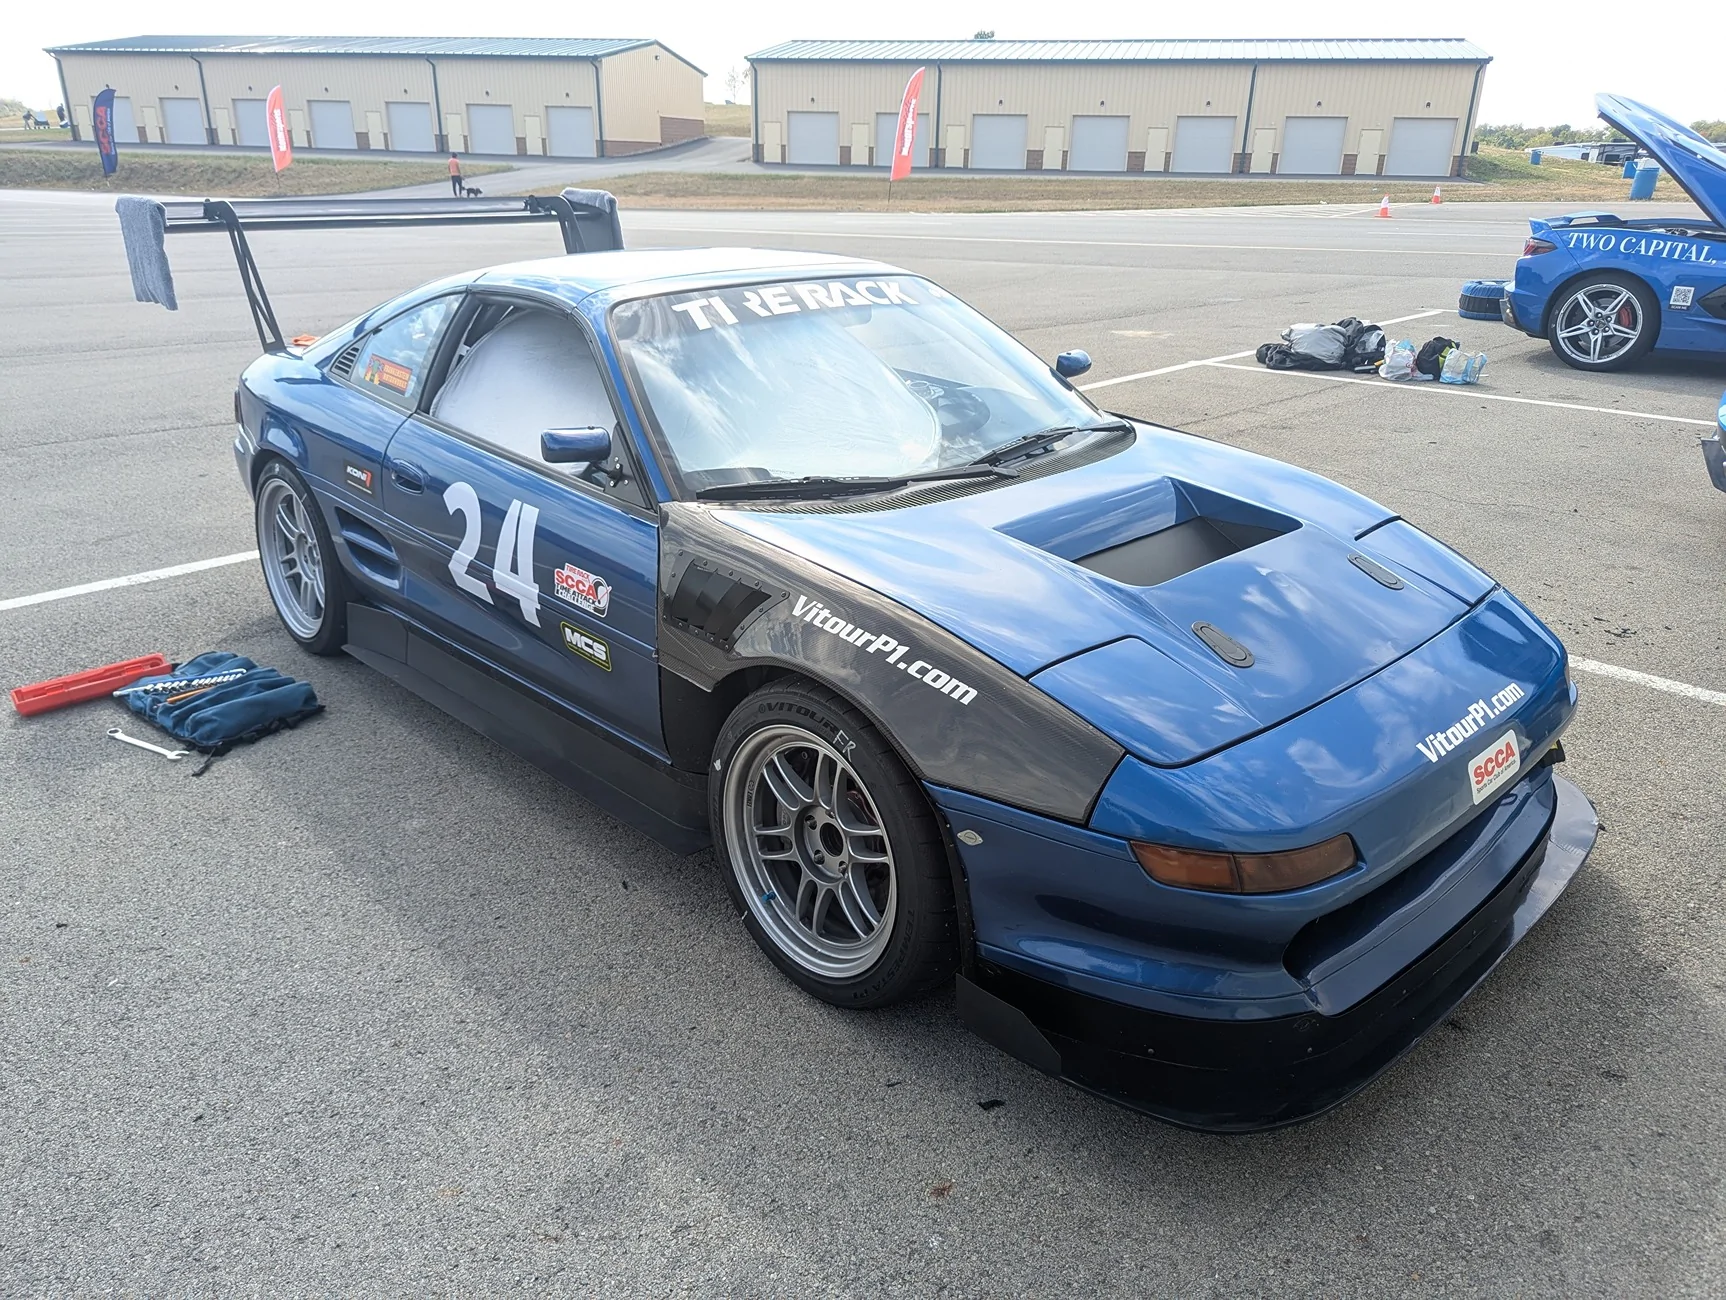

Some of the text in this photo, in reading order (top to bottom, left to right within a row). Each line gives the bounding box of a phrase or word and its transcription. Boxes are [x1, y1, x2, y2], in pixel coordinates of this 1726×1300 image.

[96, 106, 110, 154] SCCA
[1568, 232, 1717, 265] TWO CAPITAL,
[792, 280, 920, 310] RACK
[443, 481, 541, 628] 24
[555, 569, 598, 600] SCCA
[556, 583, 598, 606] TIME ATTACK
[564, 627, 607, 661] MCS
[791, 594, 978, 706] VitourP1.com
[767, 701, 840, 735] VITOUR
[1415, 682, 1525, 764] VitourP1.com
[832, 729, 857, 762] FR
[1473, 741, 1516, 785] SCCA
